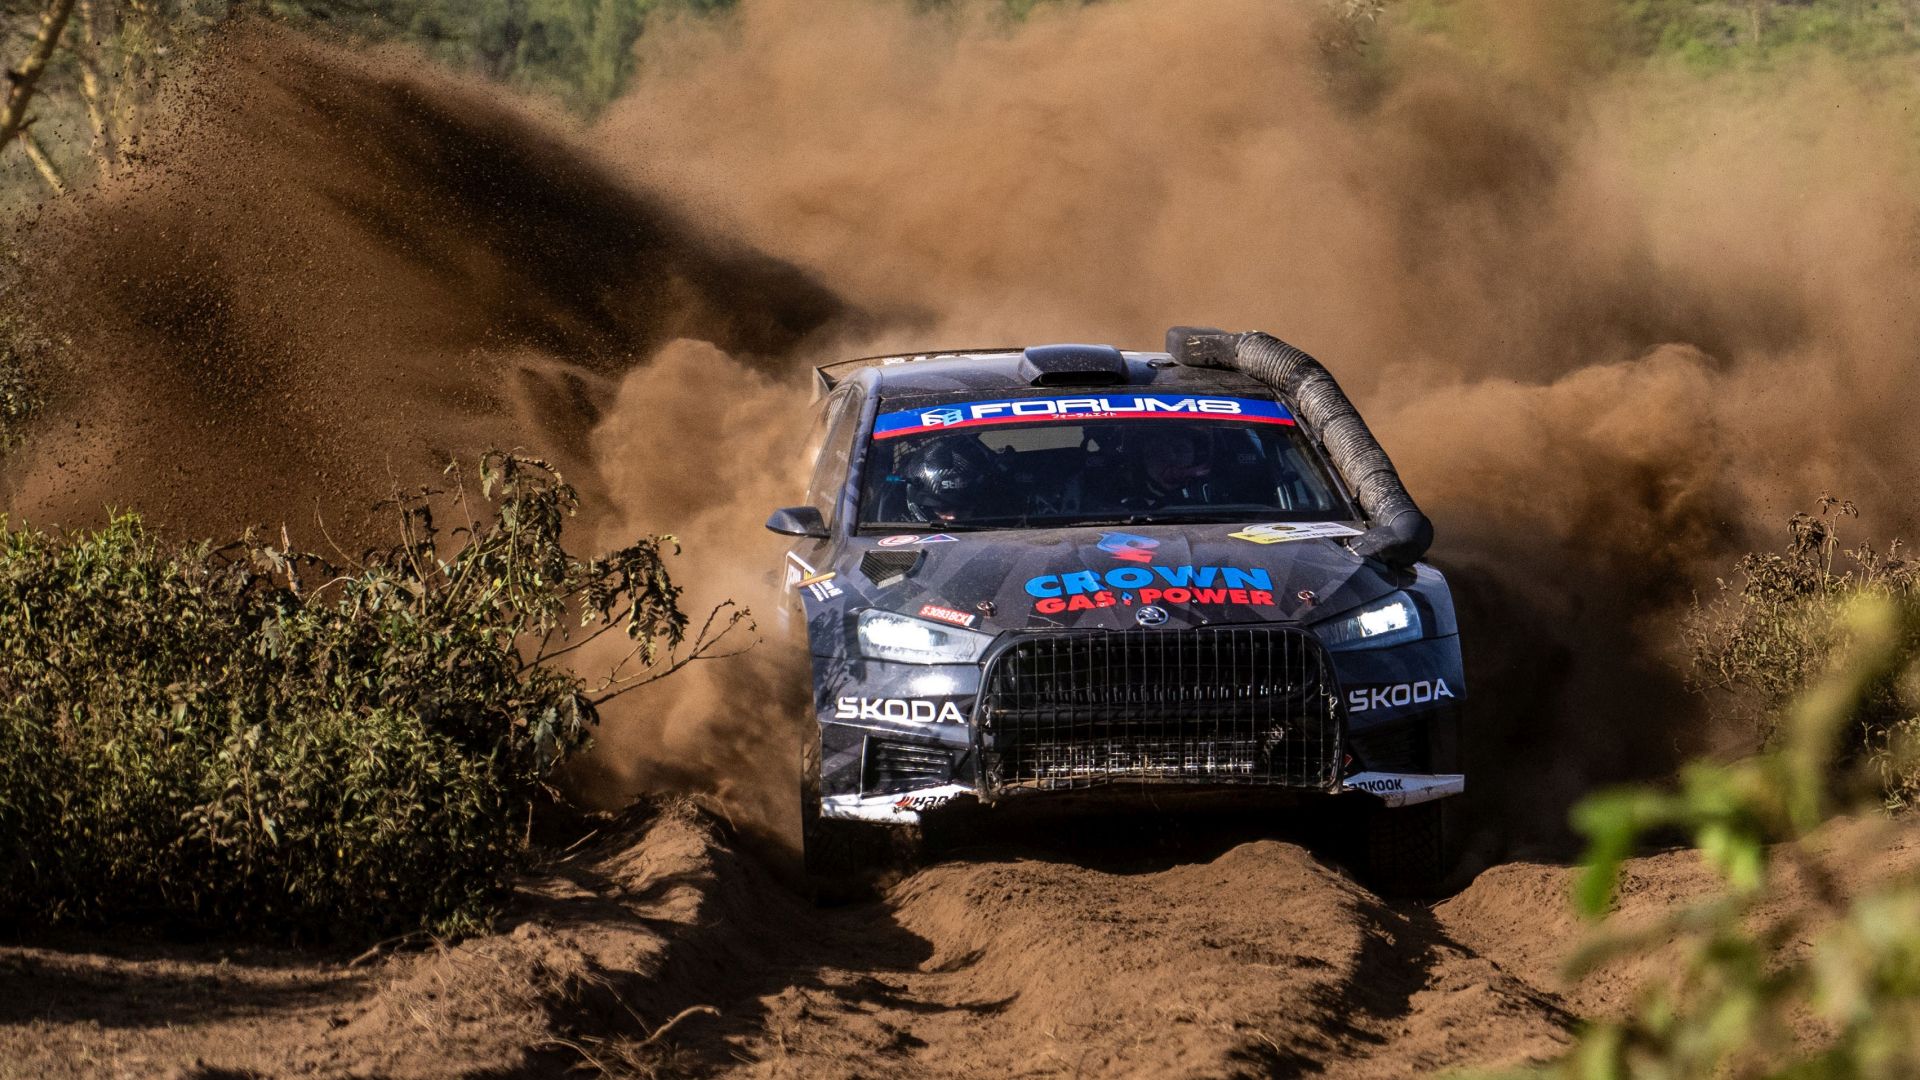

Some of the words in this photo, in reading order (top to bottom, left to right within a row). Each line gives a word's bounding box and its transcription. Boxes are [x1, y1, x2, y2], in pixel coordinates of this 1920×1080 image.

[972, 398, 1241, 419] FORUM8
[1025, 565, 1273, 598] CROWN
[1035, 591, 1116, 614] GAS
[1140, 588, 1276, 606] POWER
